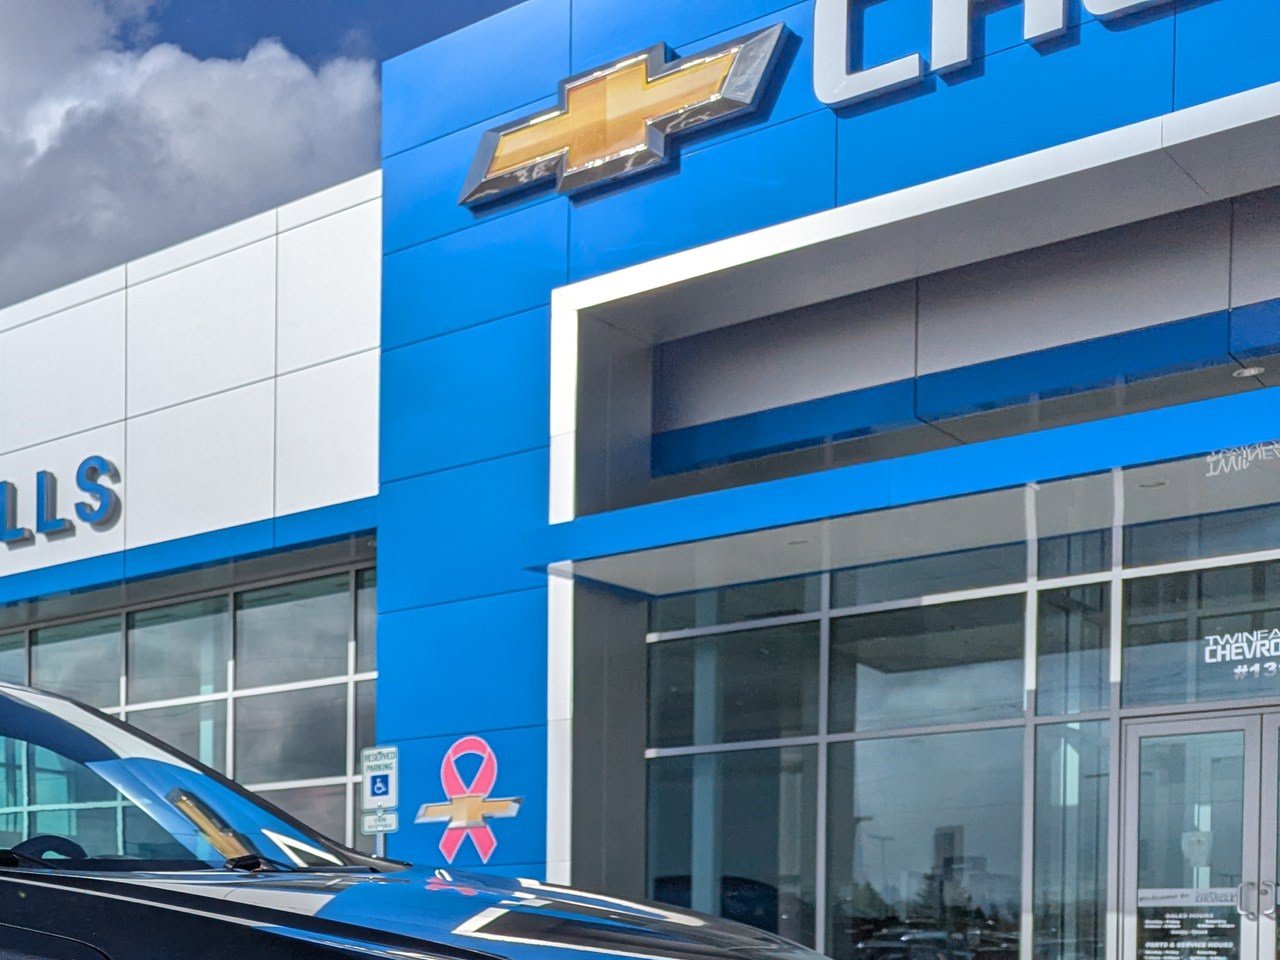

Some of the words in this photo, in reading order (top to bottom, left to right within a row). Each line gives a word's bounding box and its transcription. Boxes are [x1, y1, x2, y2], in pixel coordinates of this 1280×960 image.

[1233, 661, 1280, 681] #13
[365, 751, 396, 762] RESERVED
[366, 763, 393, 771] PARKING
